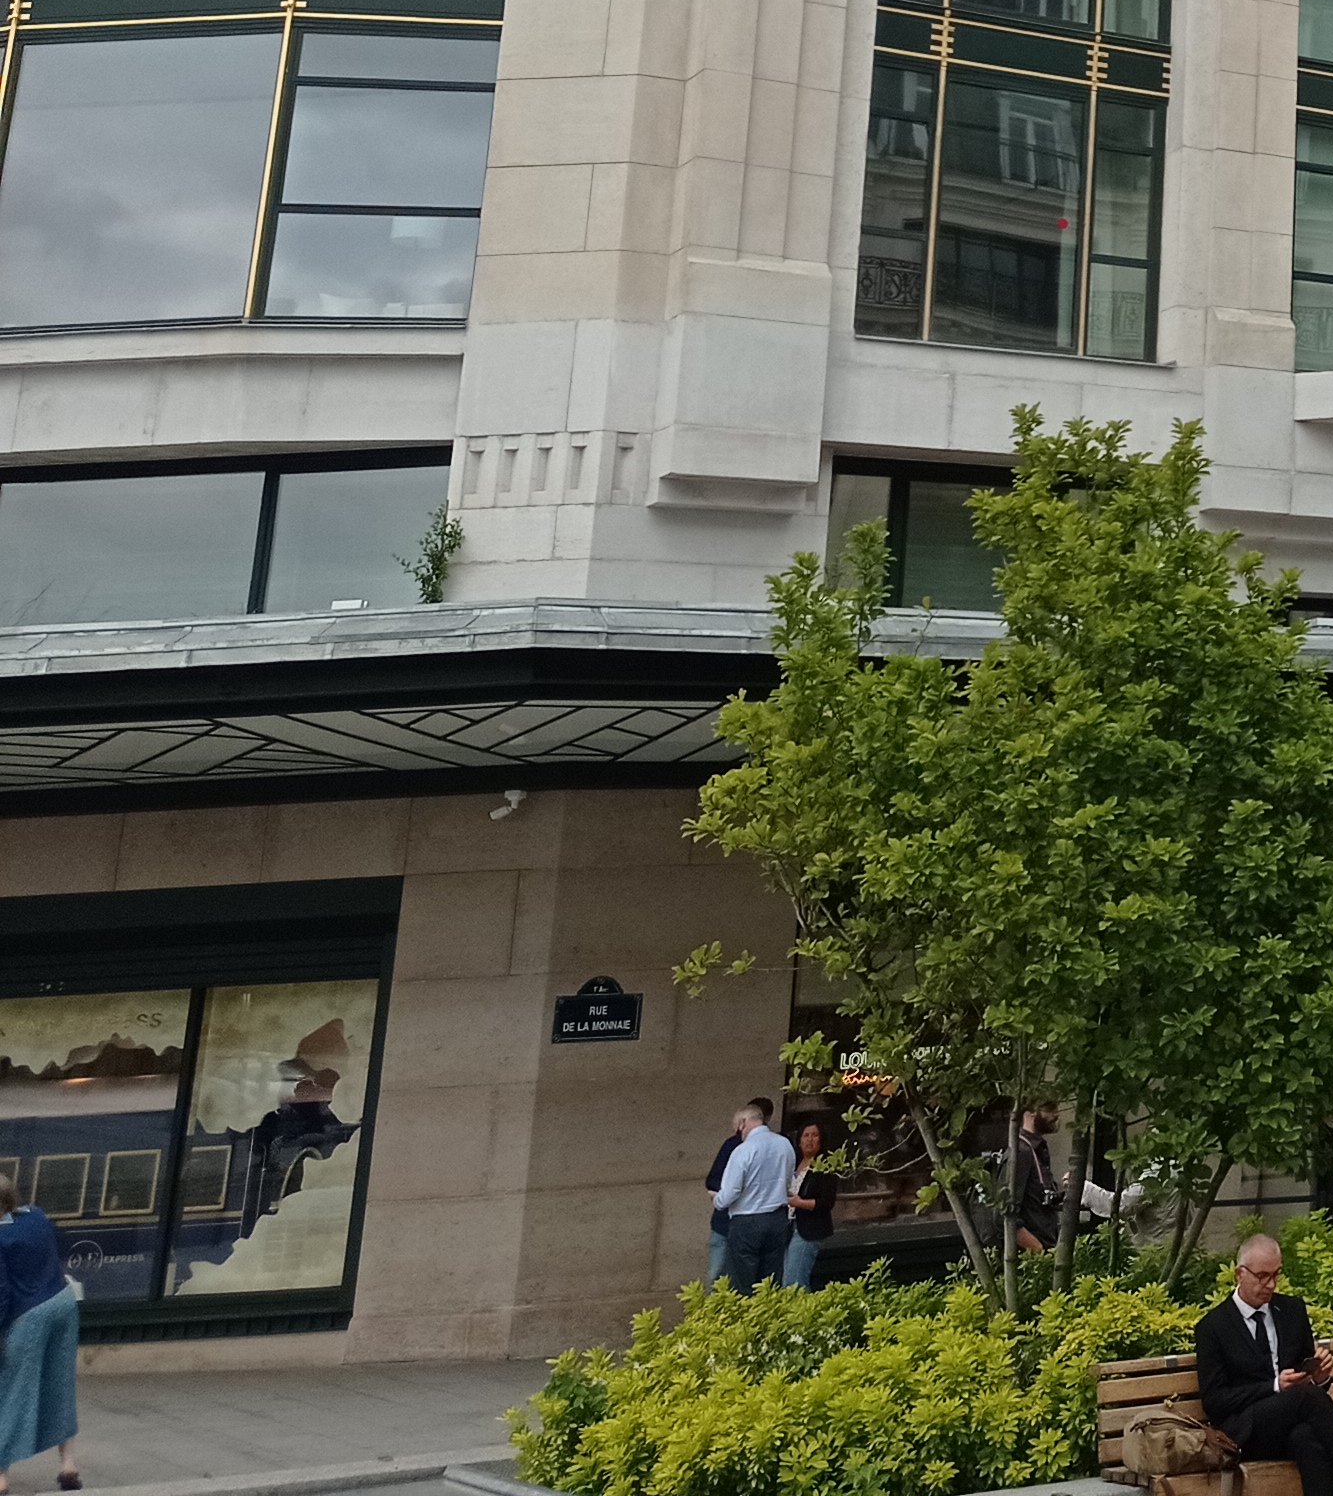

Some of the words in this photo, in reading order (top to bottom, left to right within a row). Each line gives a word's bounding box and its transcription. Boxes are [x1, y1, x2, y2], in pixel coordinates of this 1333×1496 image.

[589, 1005, 608, 1016] RUE
[562, 1022, 575, 1032] DE
[577, 1021, 590, 1032] LA
[591, 1019, 631, 1031] MONNAIE
[103, 1254, 145, 1264] EXPRESS
